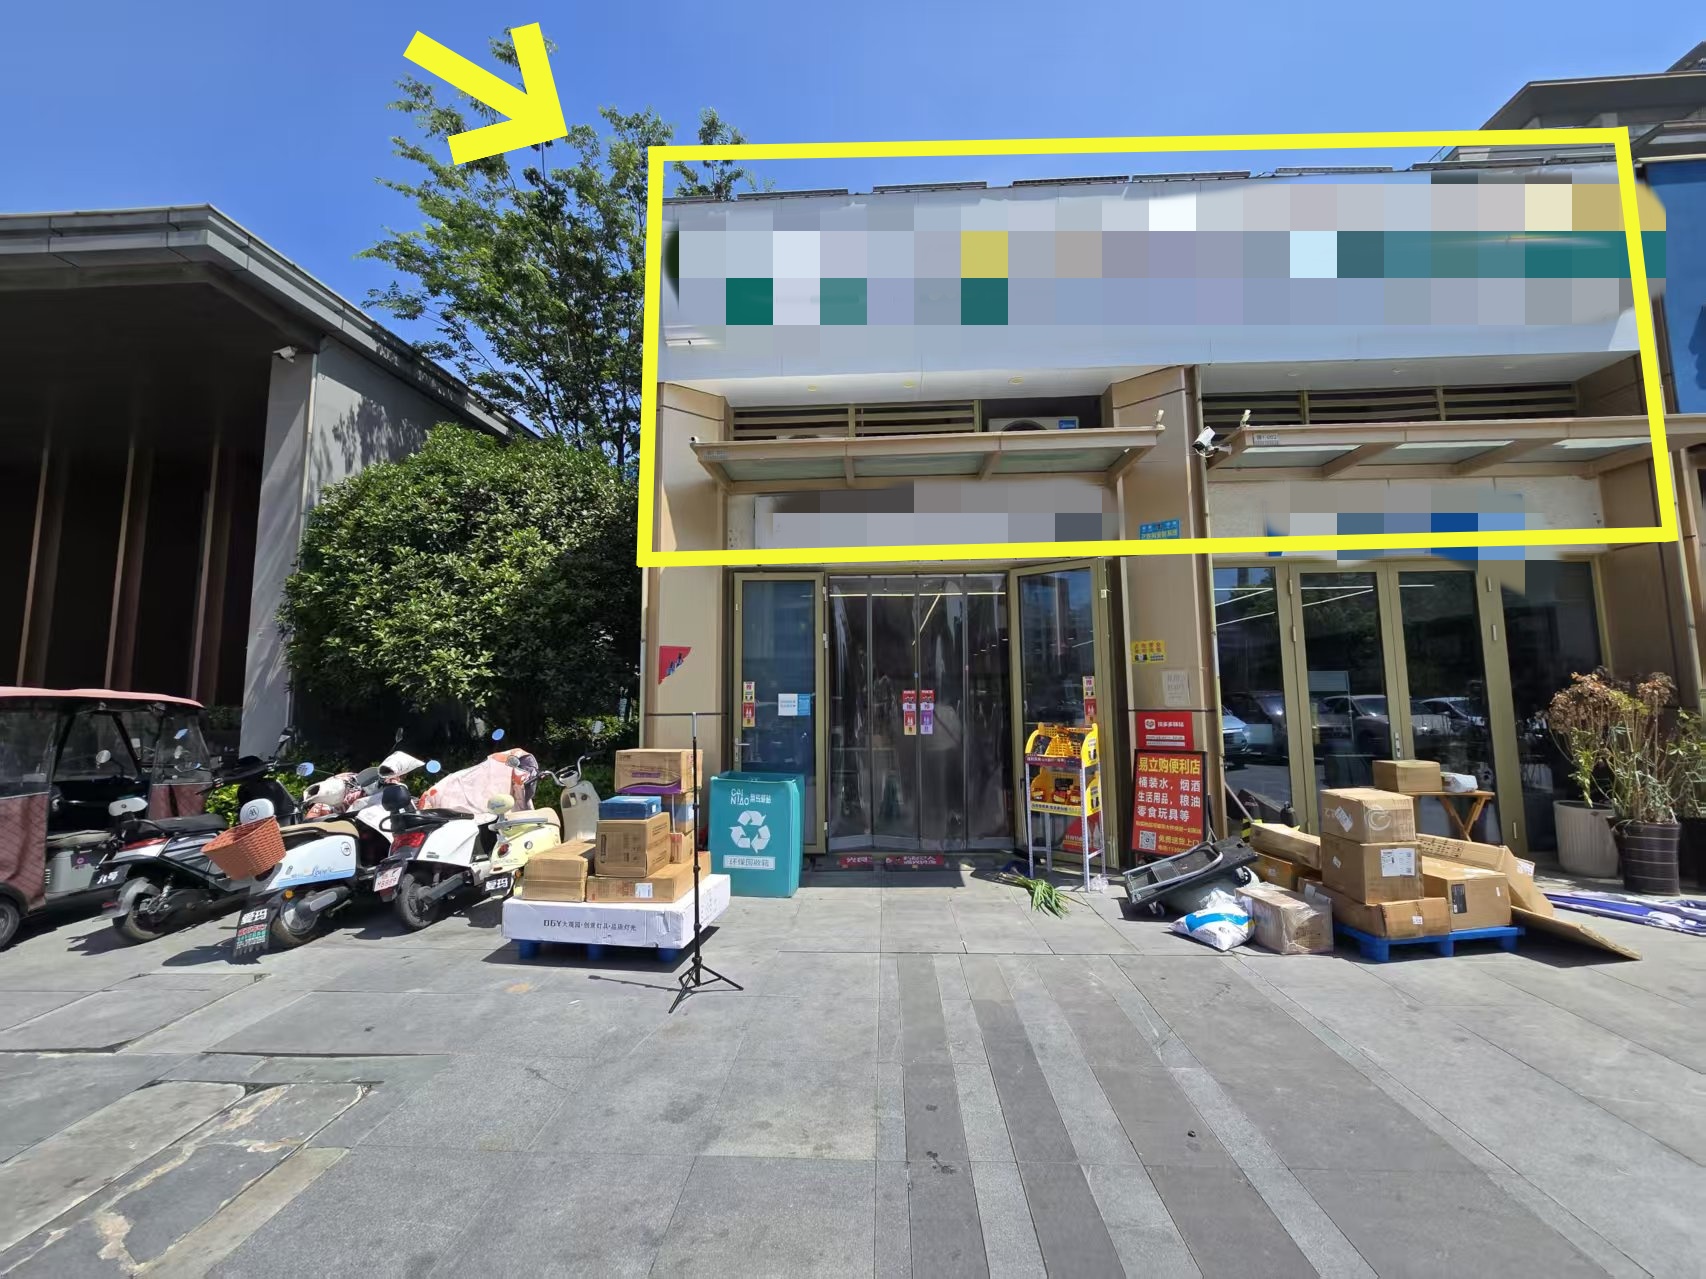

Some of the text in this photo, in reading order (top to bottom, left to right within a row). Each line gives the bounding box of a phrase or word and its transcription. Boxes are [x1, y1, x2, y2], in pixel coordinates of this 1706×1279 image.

[1138, 757, 1201, 775] 易立购便利店
[1180, 779, 1201, 792] 烟酒
[1179, 794, 1201, 808] 粮油
[1137, 805, 1190, 822] 零食玩具等
[728, 858, 770, 867] 环保回收箱
